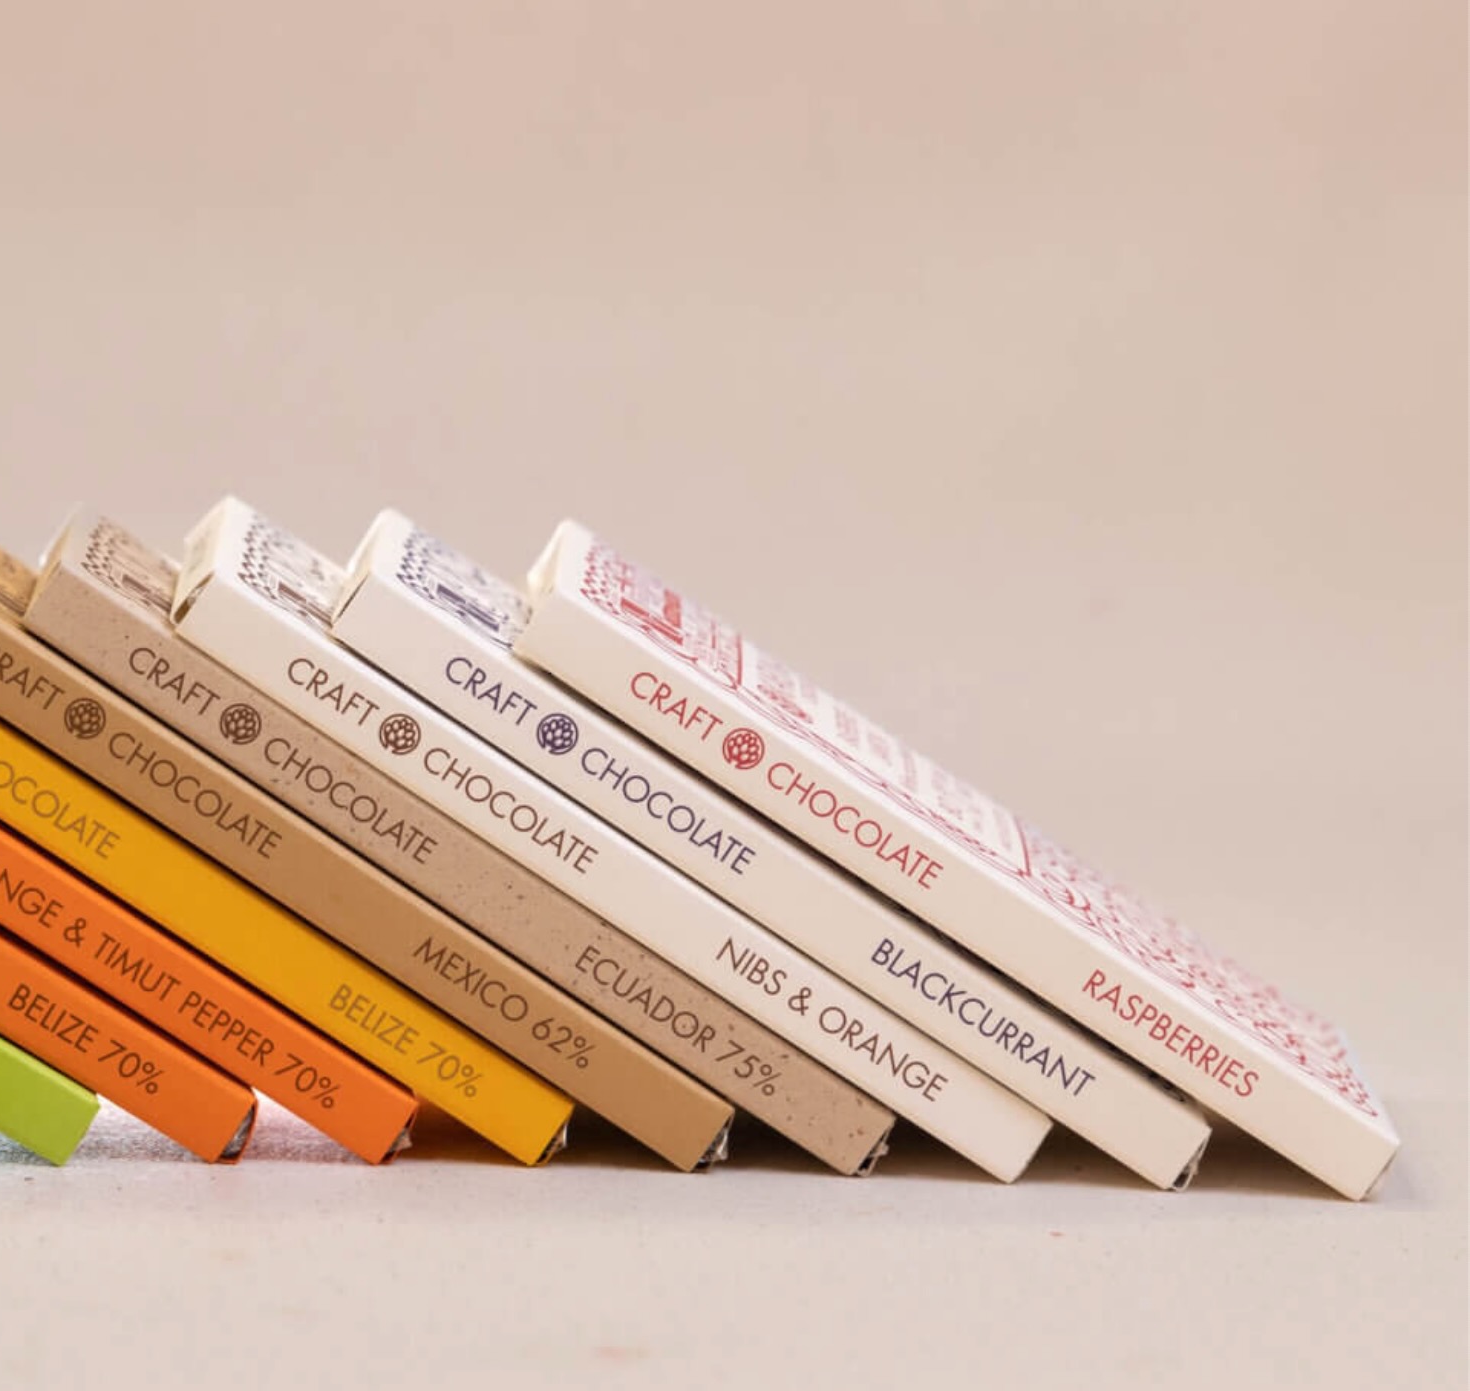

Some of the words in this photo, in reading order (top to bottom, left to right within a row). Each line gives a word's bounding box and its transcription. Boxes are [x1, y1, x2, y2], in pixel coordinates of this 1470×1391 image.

[7, 984, 103, 1055] BELIZE
[104, 1041, 166, 1094] 70%
[63, 917, 86, 948] &
[94, 933, 182, 1001] TIMUT
[178, 990, 275, 1068] PEPPER
[275, 1053, 342, 1108] 70%
[108, 732, 283, 859] CHOCOLATE
[414, 937, 530, 1023] MEXICO
[531, 1016, 593, 1070] 62%
[129, 647, 221, 715] CRAFT
[264, 738, 439, 865] CHOCOLATE
[574, 946, 716, 1054] ECUADOR
[720, 1039, 780, 1097] 75%
[287, 658, 379, 726] CRAFT
[424, 748, 600, 875] CHOCOLATE
[716, 937, 787, 998] NIBS
[789, 988, 811, 1018] &
[818, 1006, 950, 1104] ORANGE
[329, 984, 421, 1056] BELIZE
[423, 1044, 484, 1098] 70%
[445, 657, 538, 726] CRAFT
[581, 748, 757, 875] CHOCOLATE
[870, 939, 1096, 1098] BLACKCURRANT
[630, 672, 723, 741] CRAFT
[766, 763, 944, 890] CHOCOLATE
[1081, 969, 1259, 1098] RASPBERRIES
